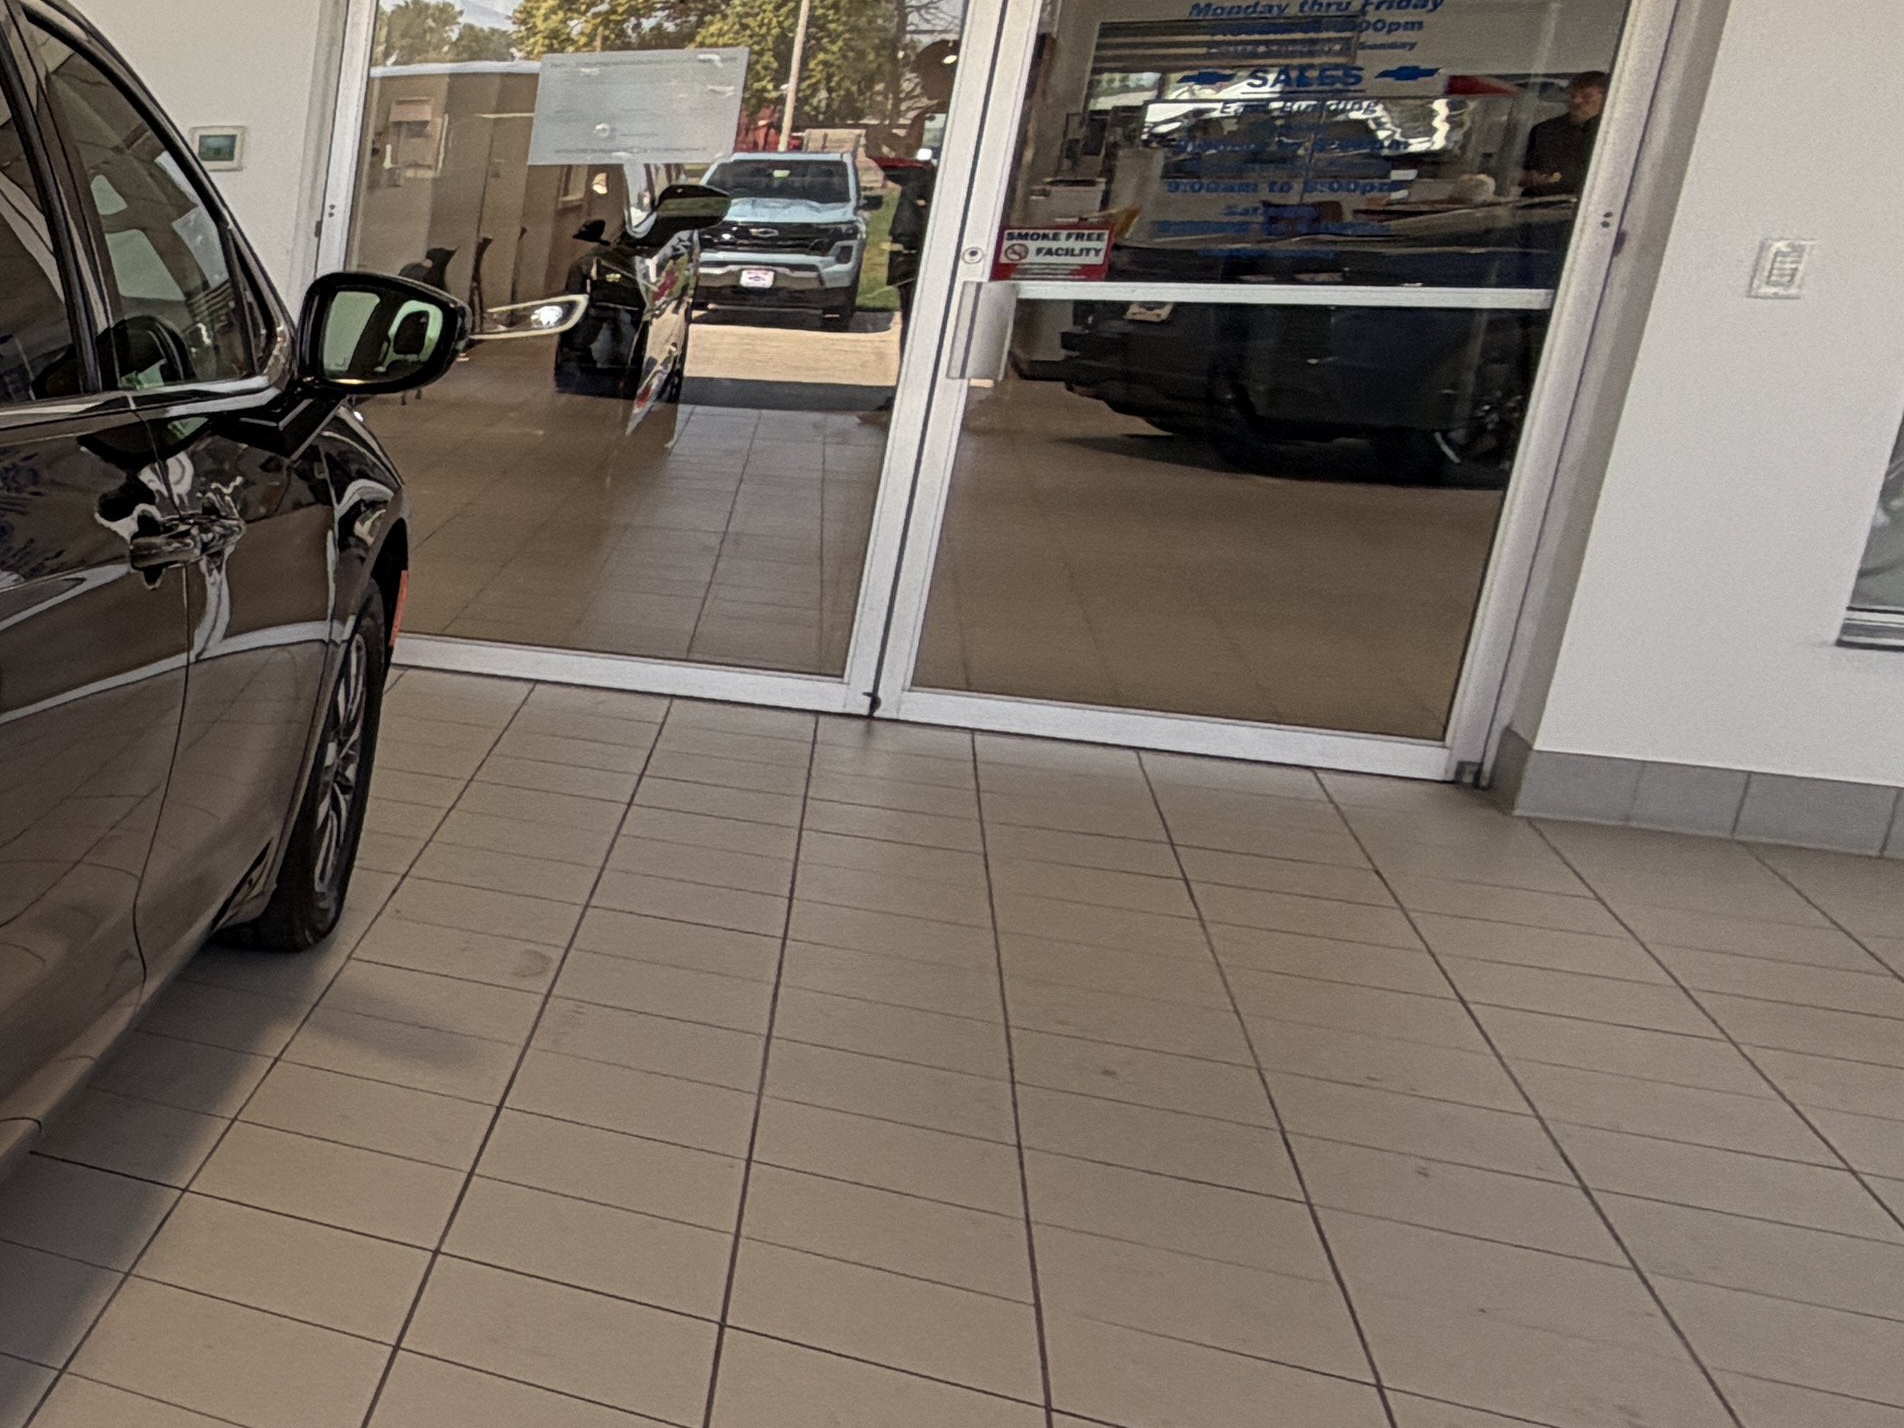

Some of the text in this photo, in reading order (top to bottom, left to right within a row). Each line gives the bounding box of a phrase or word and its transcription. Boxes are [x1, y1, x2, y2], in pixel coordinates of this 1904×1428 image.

[1298, 0, 1352, 14] thru
[1005, 231, 1107, 242] SMOKE FREE
[1035, 246, 1103, 257] FACILITY
